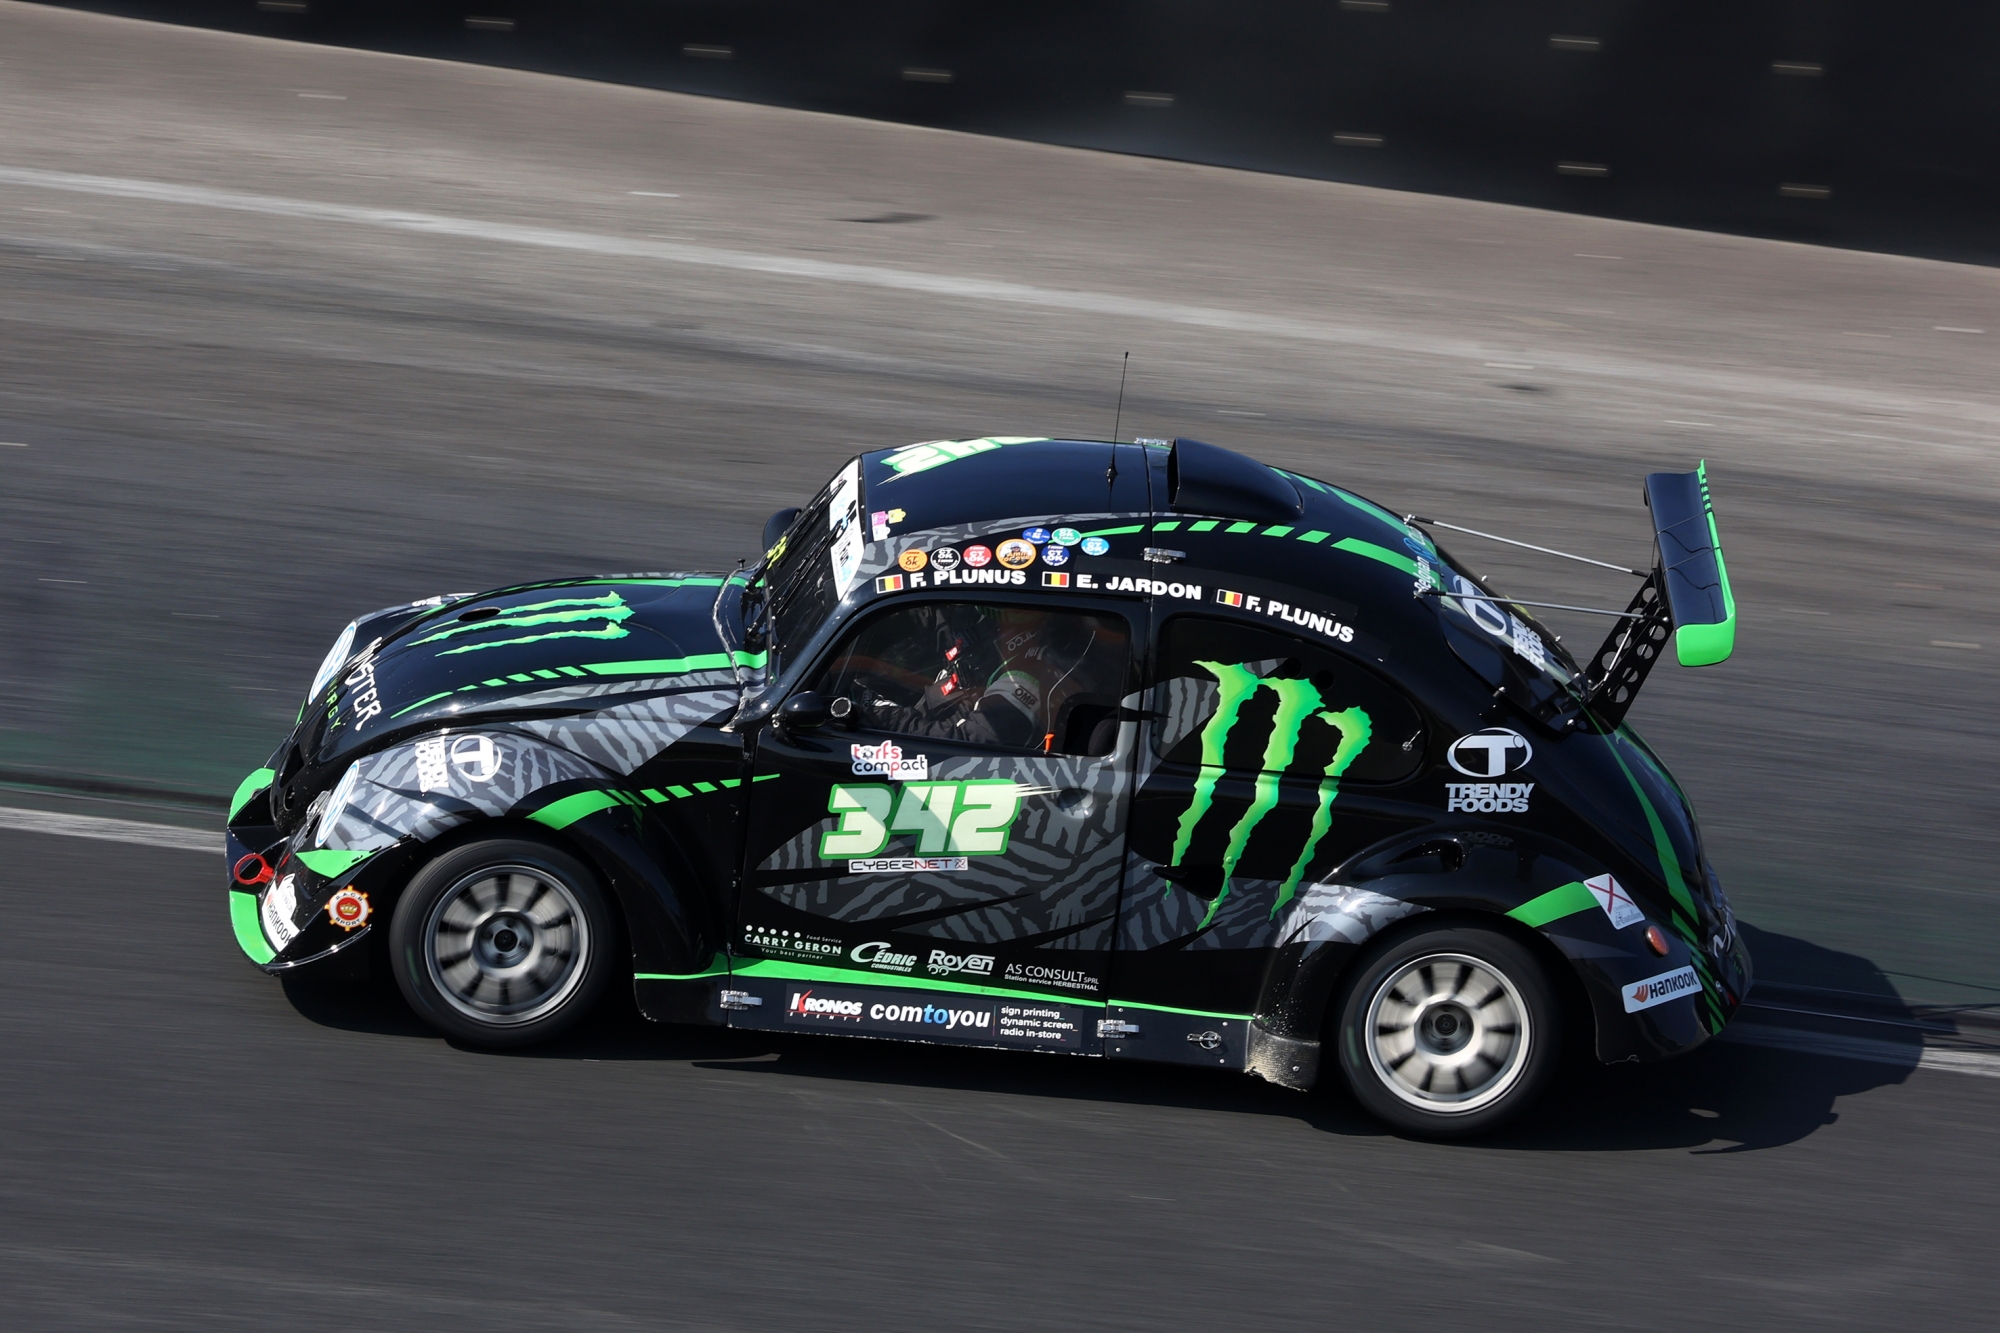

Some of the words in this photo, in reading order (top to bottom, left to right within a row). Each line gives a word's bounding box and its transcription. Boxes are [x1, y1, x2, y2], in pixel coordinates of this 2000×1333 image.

[881, 437, 1052, 472] 42
[910, 572, 926, 588] F.
[934, 569, 1026, 586] PLUNUS
[1076, 574, 1098, 589] E.
[1106, 576, 1202, 599] JARDON
[1246, 596, 1261, 613] F.
[1267, 602, 1354, 642] PLUNUS
[1007, 630, 1037, 651] arco
[344, 636, 382, 731] MNSTER
[326, 677, 342, 729] NERGY
[1015, 687, 1037, 706] OMP
[854, 757, 925, 777] compact
[1445, 783, 1535, 799] TRENDY
[1447, 798, 1529, 813] FOODS
[819, 779, 1021, 859] 342
[335, 917, 361, 926] SPORT
[744, 934, 788, 947] CARRY
[794, 940, 842, 955] GERON
[851, 941, 918, 967] CÉDRIC
[797, 953, 824, 961] partner
[928, 949, 995, 975] Royen
[871, 964, 913, 973] COMBUSTIBLES
[1005, 963, 1022, 975] AS
[1025, 966, 1085, 982] CONSULT
[1083, 977, 1100, 985] SPRL
[1004, 974, 1027, 982] Station
[1028, 977, 1052, 985] service
[1053, 980, 1099, 991] HERBESTHAL
[790, 990, 863, 1015] KRONOS
[1001, 1006, 1020, 1016] sign
[870, 1003, 991, 1030] comtoyou
[1000, 1017, 1041, 1027] dynamic
[1000, 1028, 1024, 1037] radio
